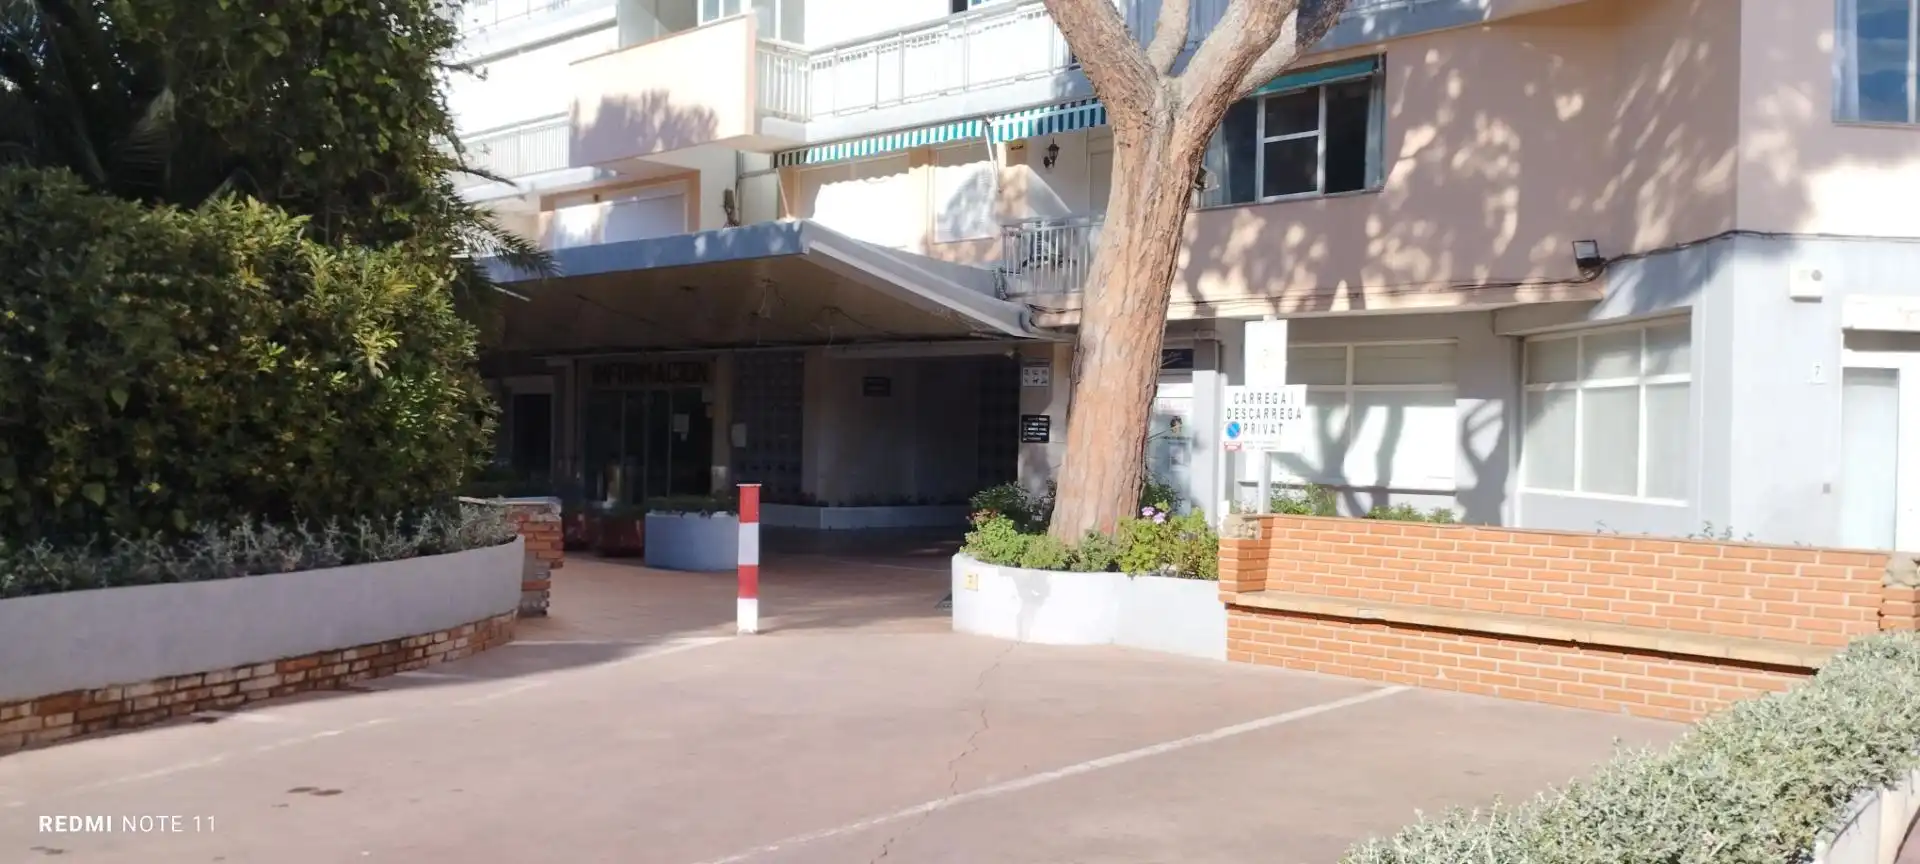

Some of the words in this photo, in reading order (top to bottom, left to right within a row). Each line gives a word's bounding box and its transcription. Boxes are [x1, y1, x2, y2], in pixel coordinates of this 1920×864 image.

[1234, 392, 1287, 405] CARREGA
[1226, 407, 1302, 420] DESCARREGA
[1243, 423, 1284, 435] PRIVAT
